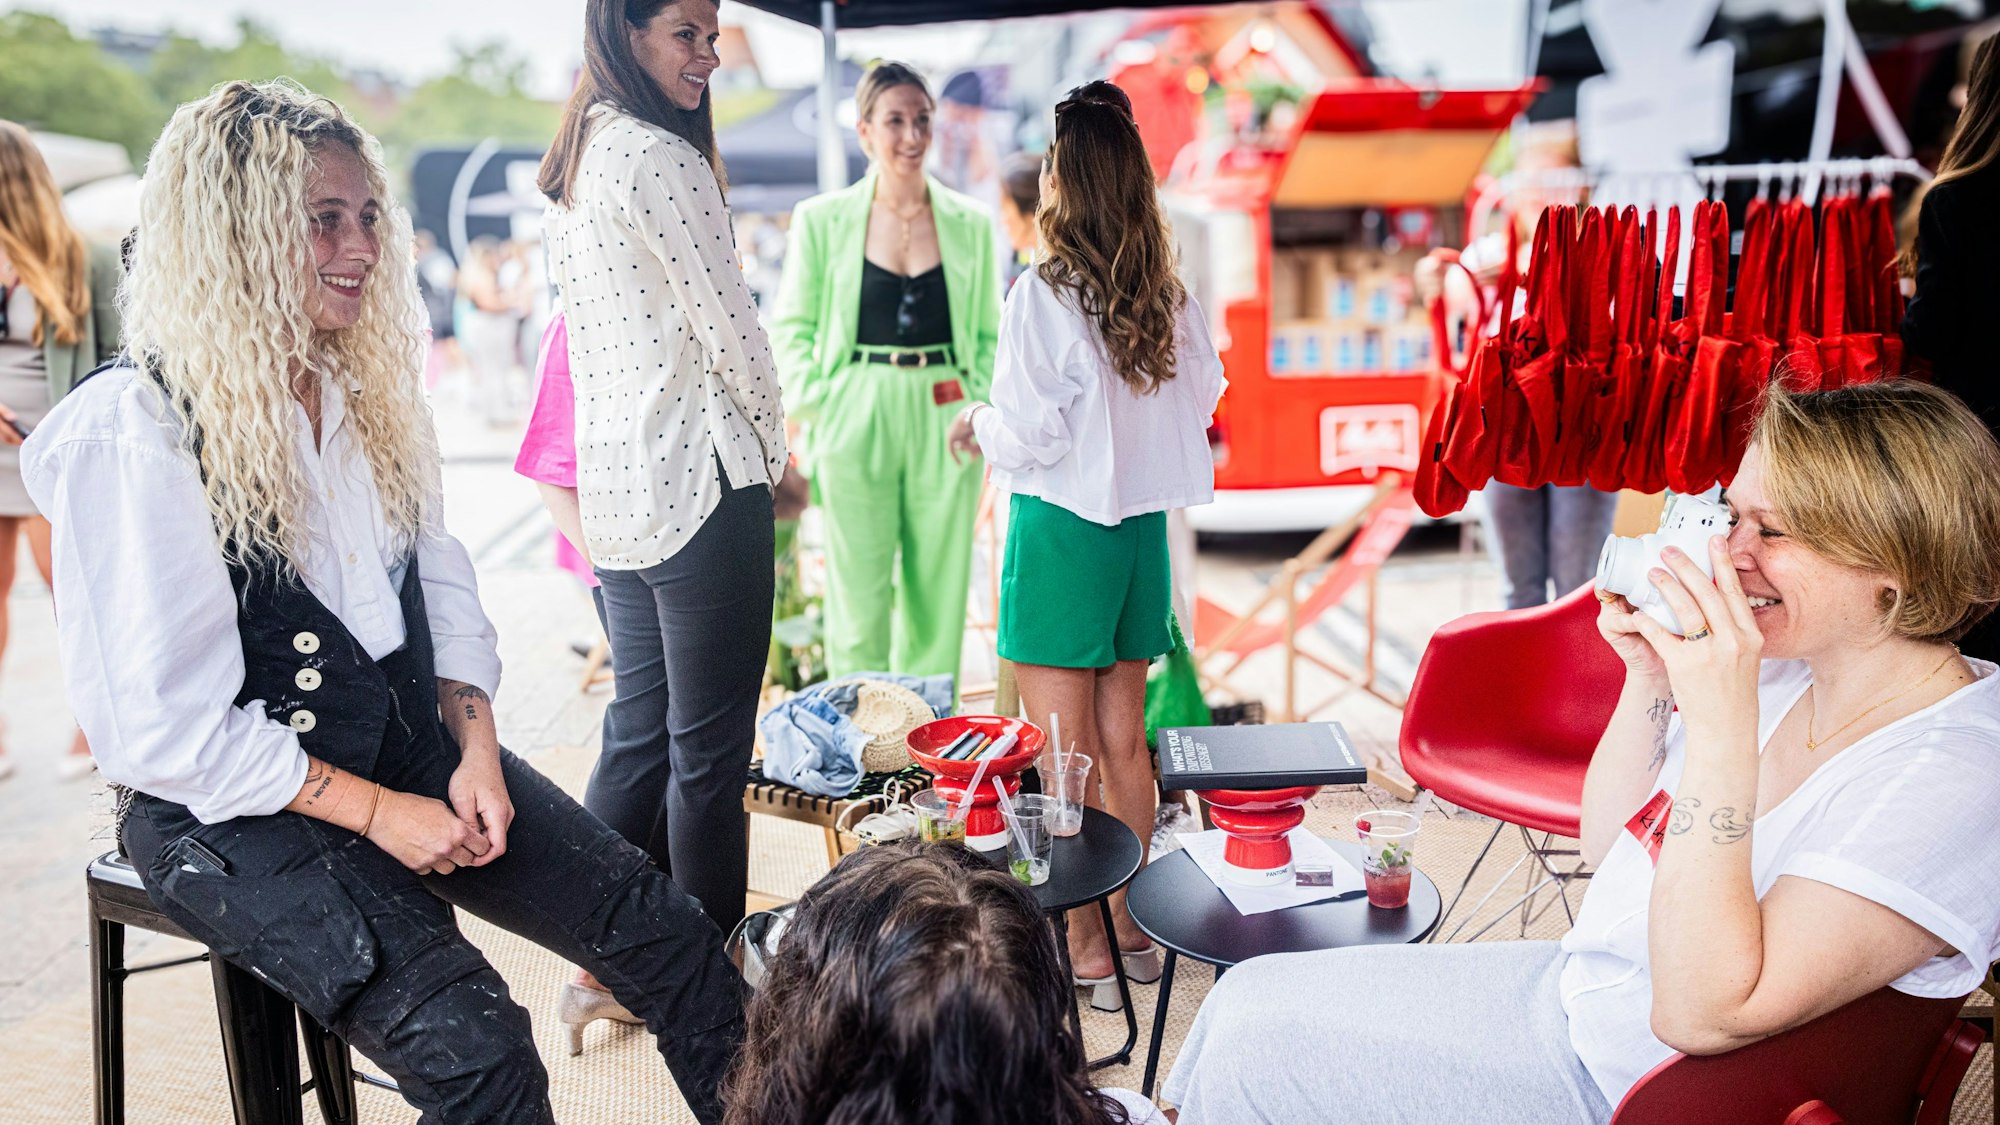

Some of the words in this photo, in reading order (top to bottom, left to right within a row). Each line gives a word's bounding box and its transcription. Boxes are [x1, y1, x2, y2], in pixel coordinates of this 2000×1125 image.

[1167, 730, 1181, 748] YOUR
[1170, 747, 1186, 772] WHAT'S
[1181, 735, 1200, 771] EMPOWERING
[1195, 742, 1213, 771] MESSAGE?
[312, 776, 332, 799] NEVER
[1265, 868, 1288, 877] PANTONE
